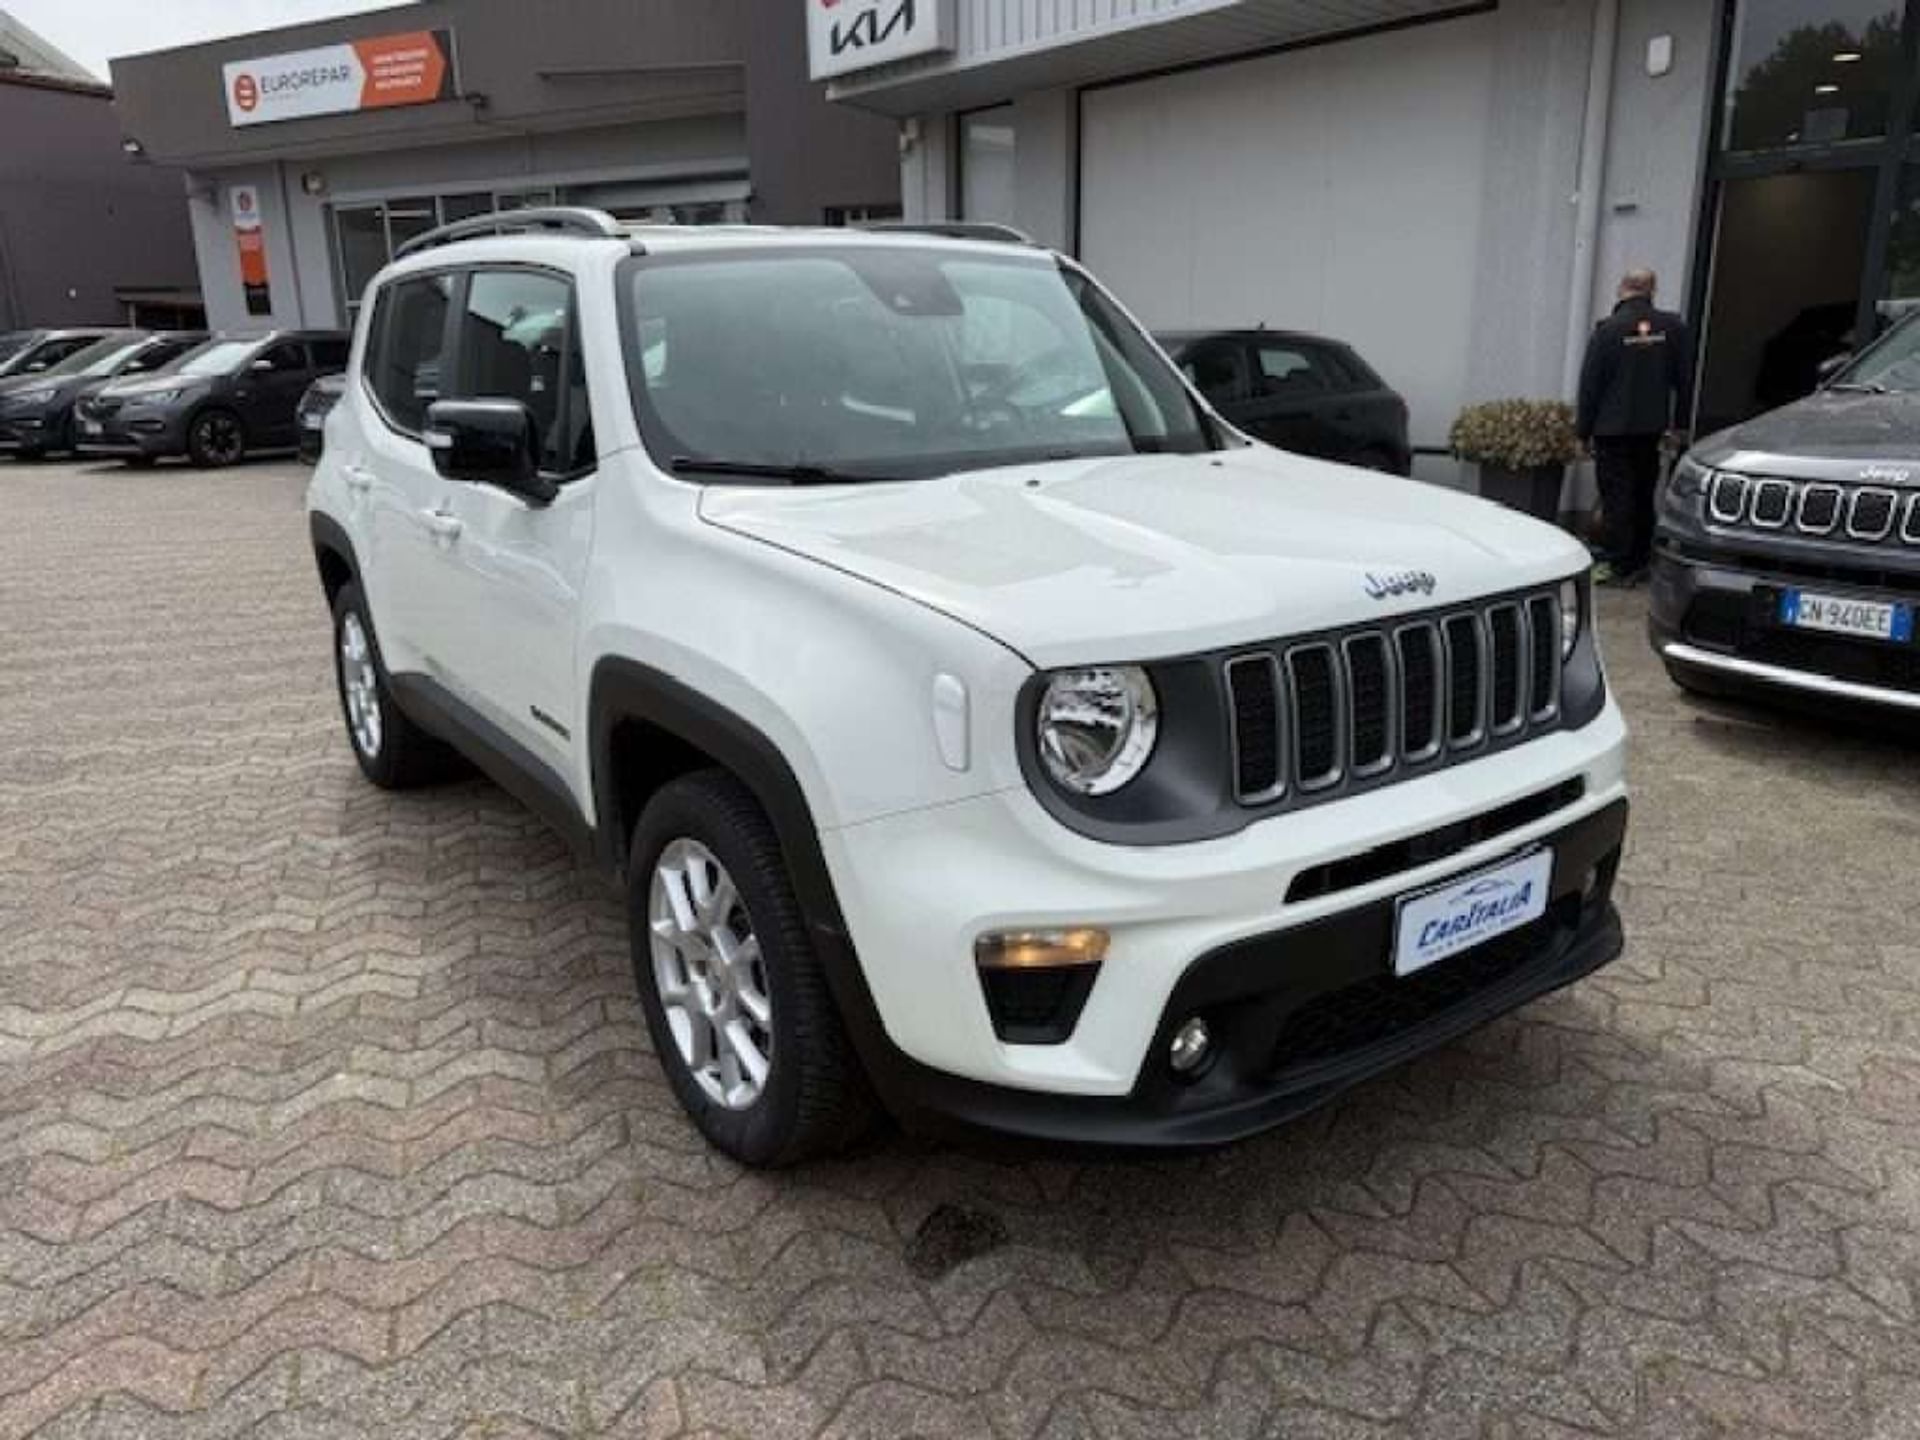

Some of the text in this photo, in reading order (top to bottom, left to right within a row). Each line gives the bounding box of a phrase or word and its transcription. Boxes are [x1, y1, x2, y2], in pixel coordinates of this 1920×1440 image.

[830, 0, 916, 55] KIA
[260, 65, 351, 94] EUROREPAR
[1364, 570, 1437, 601] Jeep
